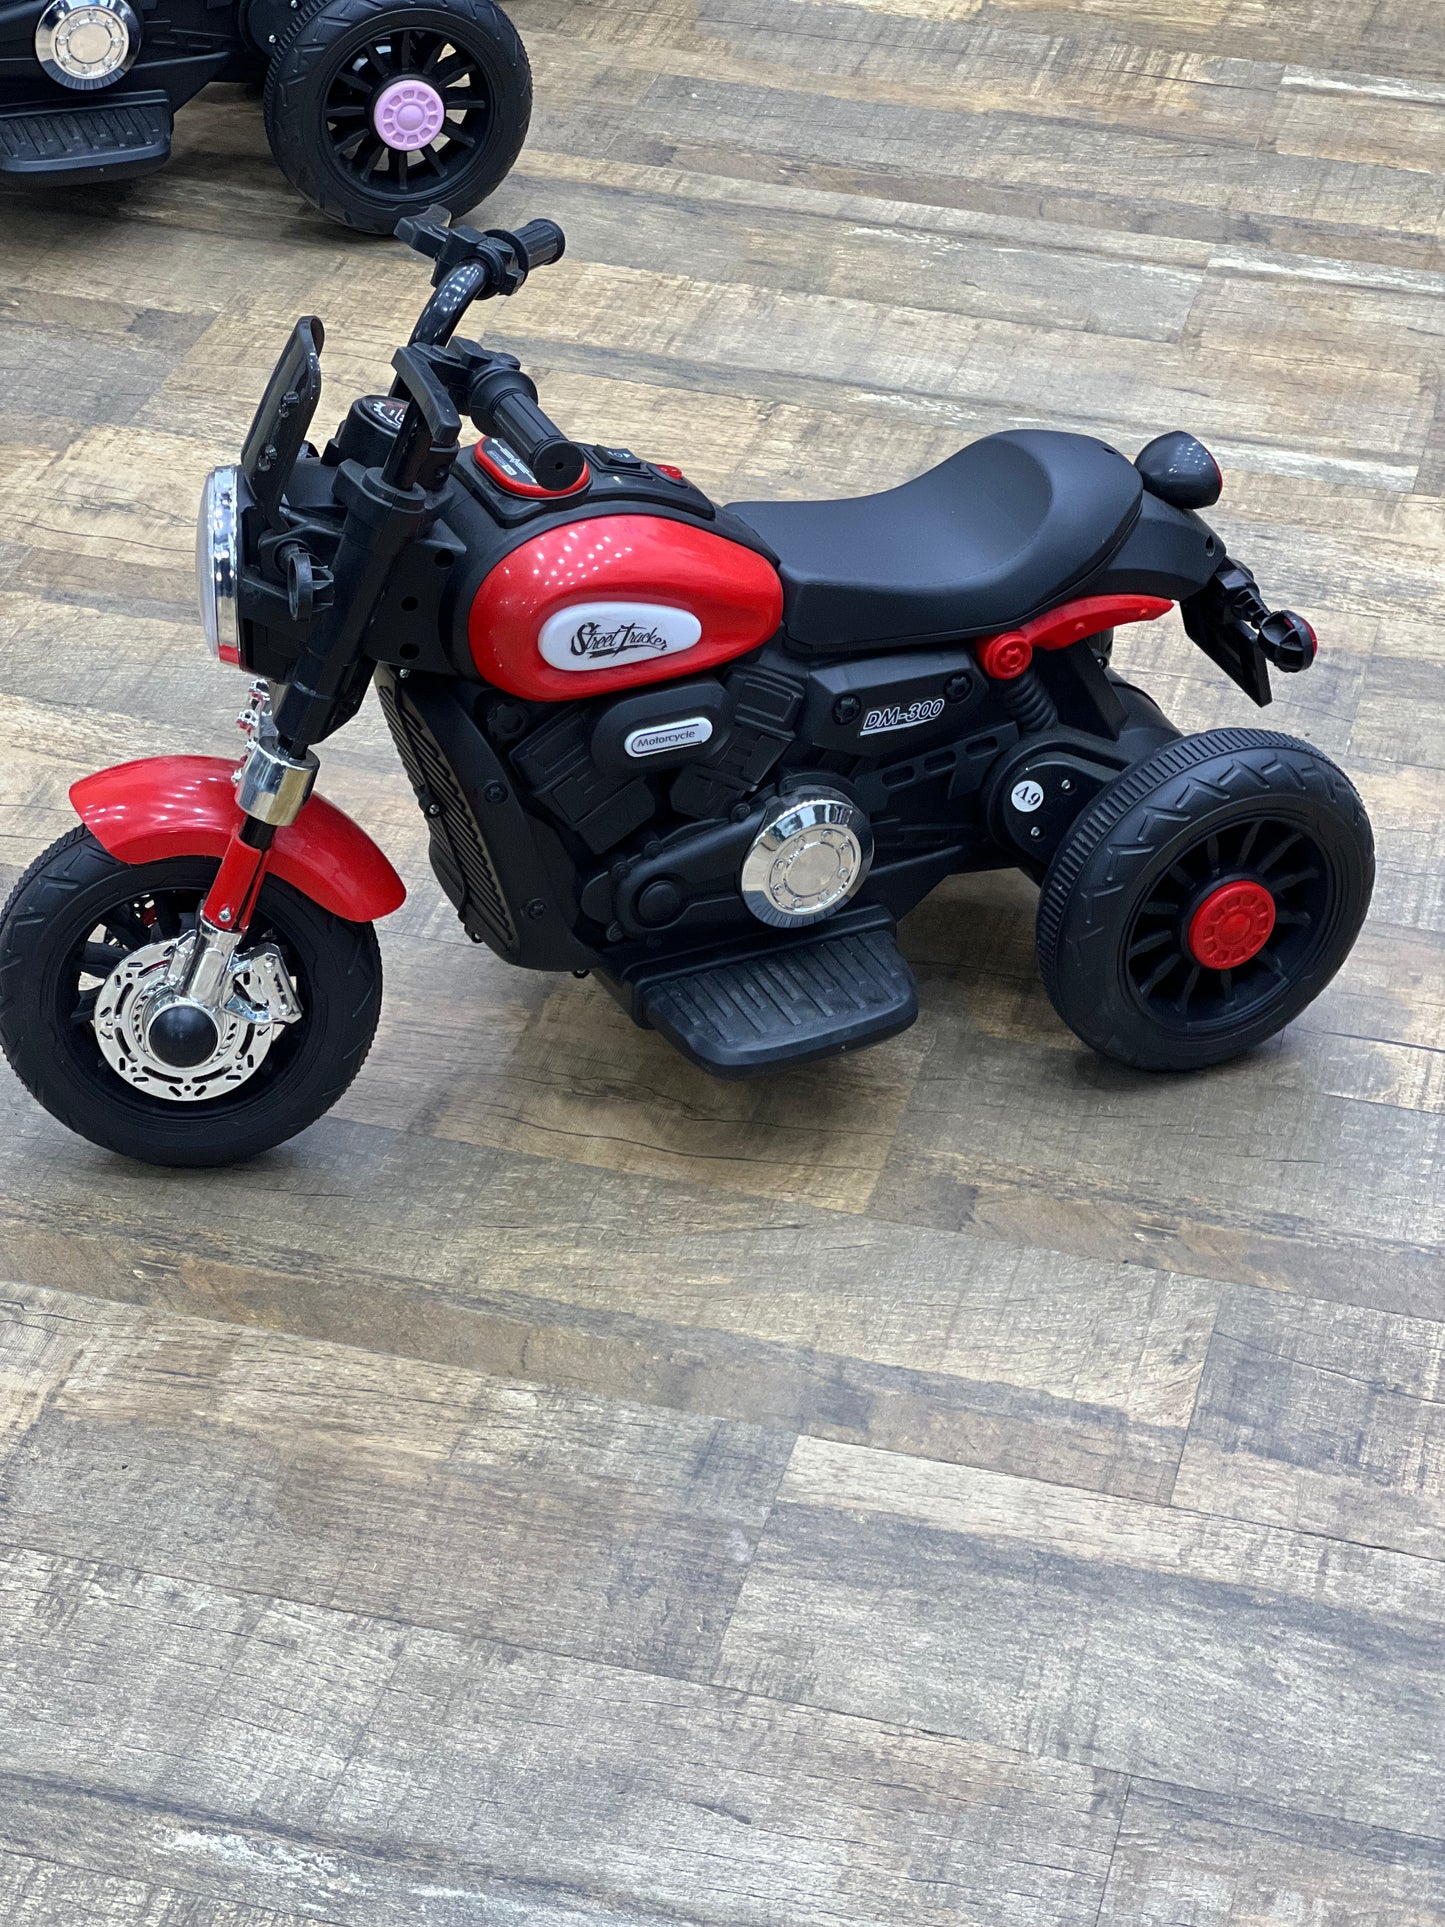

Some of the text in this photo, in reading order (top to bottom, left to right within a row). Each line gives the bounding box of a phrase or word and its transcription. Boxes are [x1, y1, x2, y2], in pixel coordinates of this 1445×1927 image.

[570, 622, 668, 656] Street Tracker
[862, 698, 945, 731] DM-300
[637, 730, 696, 748] Motorcycle
